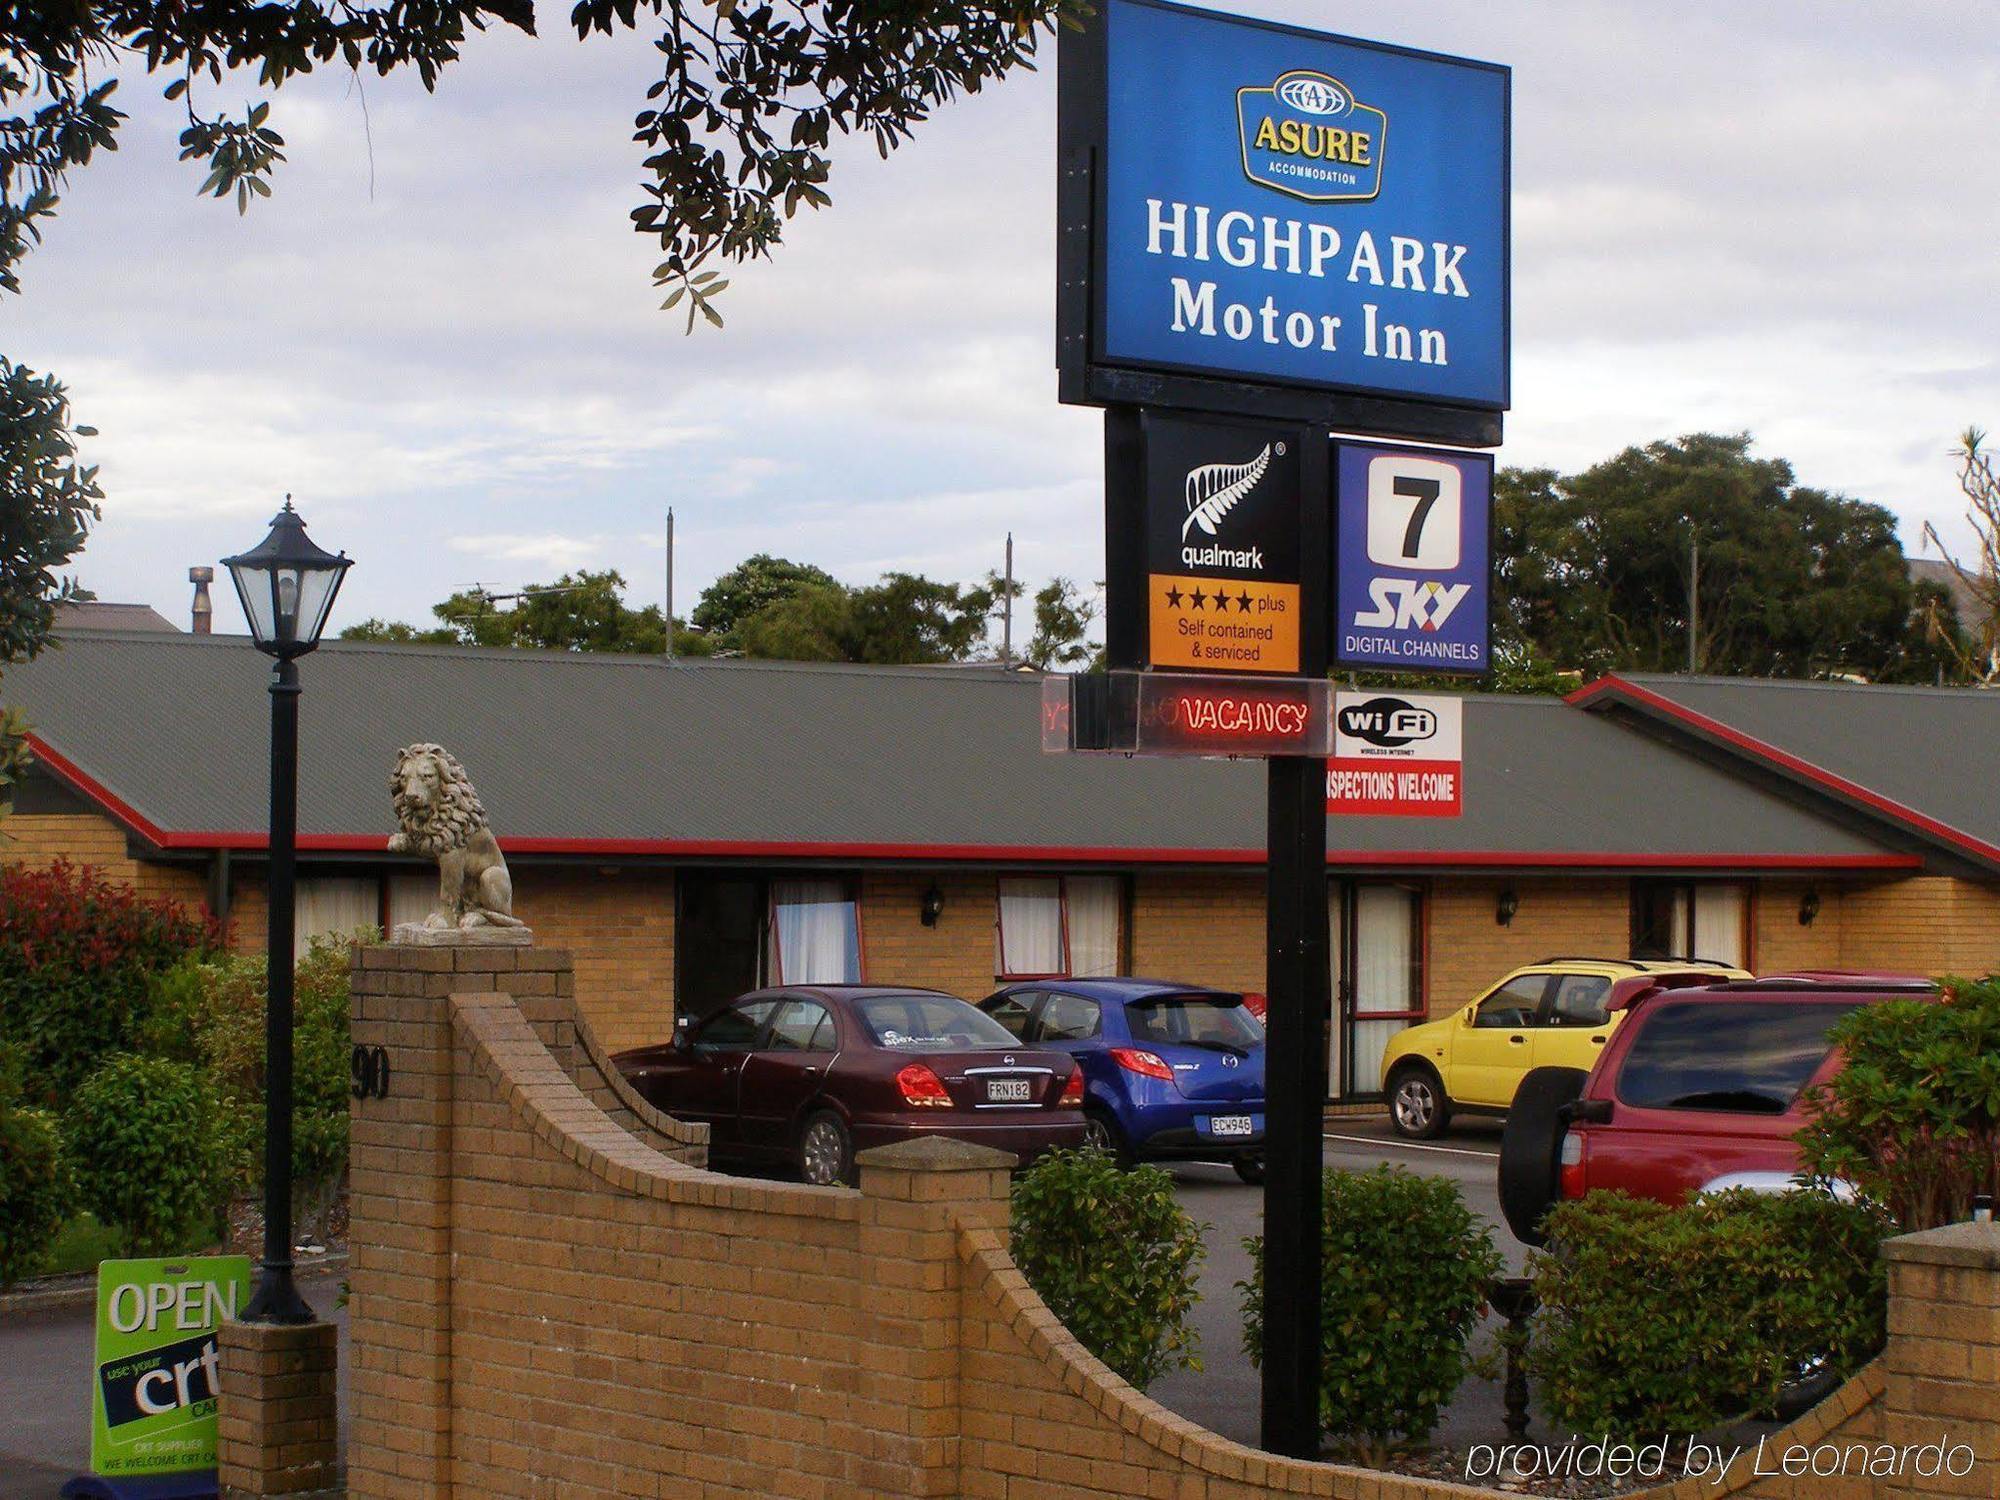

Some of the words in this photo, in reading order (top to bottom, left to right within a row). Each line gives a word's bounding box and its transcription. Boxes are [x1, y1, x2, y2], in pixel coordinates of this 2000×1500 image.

[1255, 116, 1372, 165] ASURE
[1268, 162, 1356, 185] ACCOMMODATION
[1146, 199, 1469, 298] HIGHPARK
[1170, 277, 1341, 352] Motor
[1363, 304, 1448, 366] Inn
[1393, 476, 1440, 558] 7
[1181, 544, 1263, 569] qualmark
[1258, 594, 1285, 614] plus
[1354, 577, 1471, 632] SKY
[1178, 618, 1204, 635] Self
[1208, 622, 1273, 640] contained
[1191, 642, 1201, 658] &
[1205, 644, 1260, 661] serviced
[1345, 636, 1400, 656] DIGITAL
[1402, 640, 1479, 660] CHANNELS
[1181, 698, 1308, 733] VACANCY
[1397, 772, 1454, 801] WELCOME
[352, 1045, 389, 1100] 90
[989, 1083, 1029, 1097] FRN182
[1212, 1118, 1251, 1132] ECW946
[109, 1280, 238, 1333] OPEN
[135, 1340, 220, 1415] crt
